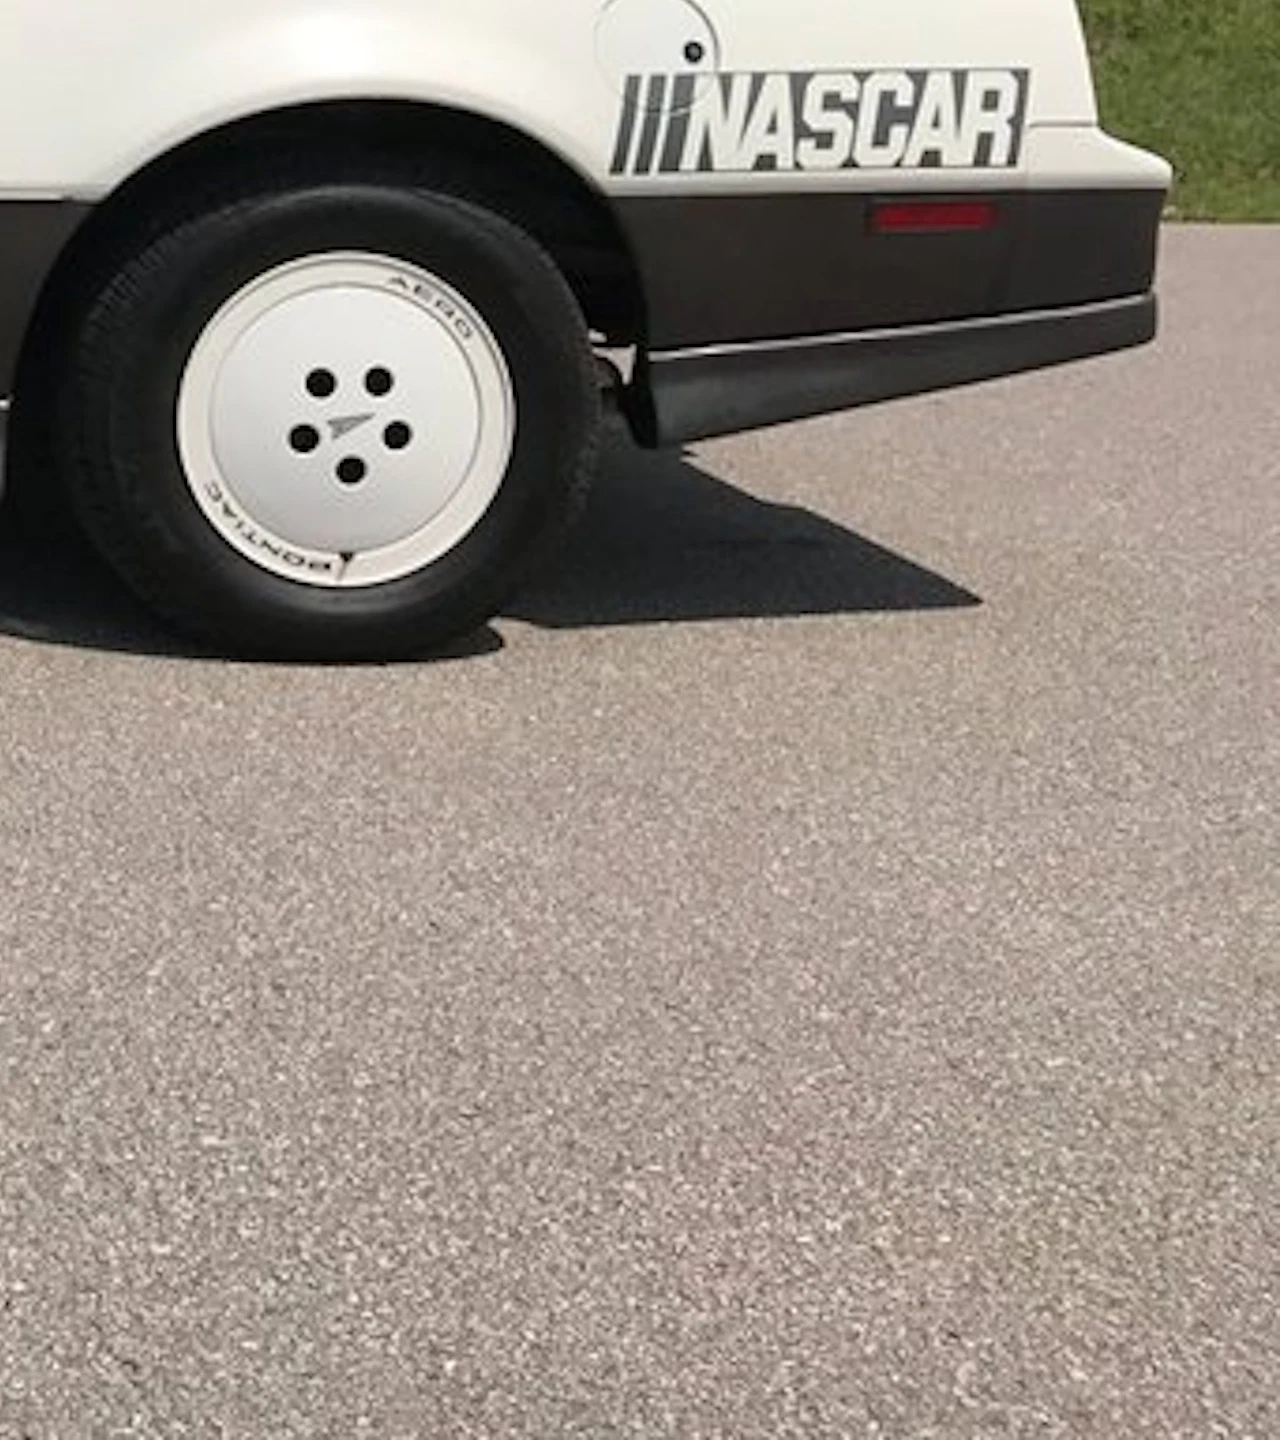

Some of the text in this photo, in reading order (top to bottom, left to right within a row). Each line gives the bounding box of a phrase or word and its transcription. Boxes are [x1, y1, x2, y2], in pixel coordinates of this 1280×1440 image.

[678, 70, 1020, 172] NASCAR
[389, 276, 473, 339] AERO
[203, 481, 331, 571] PONTIAC
